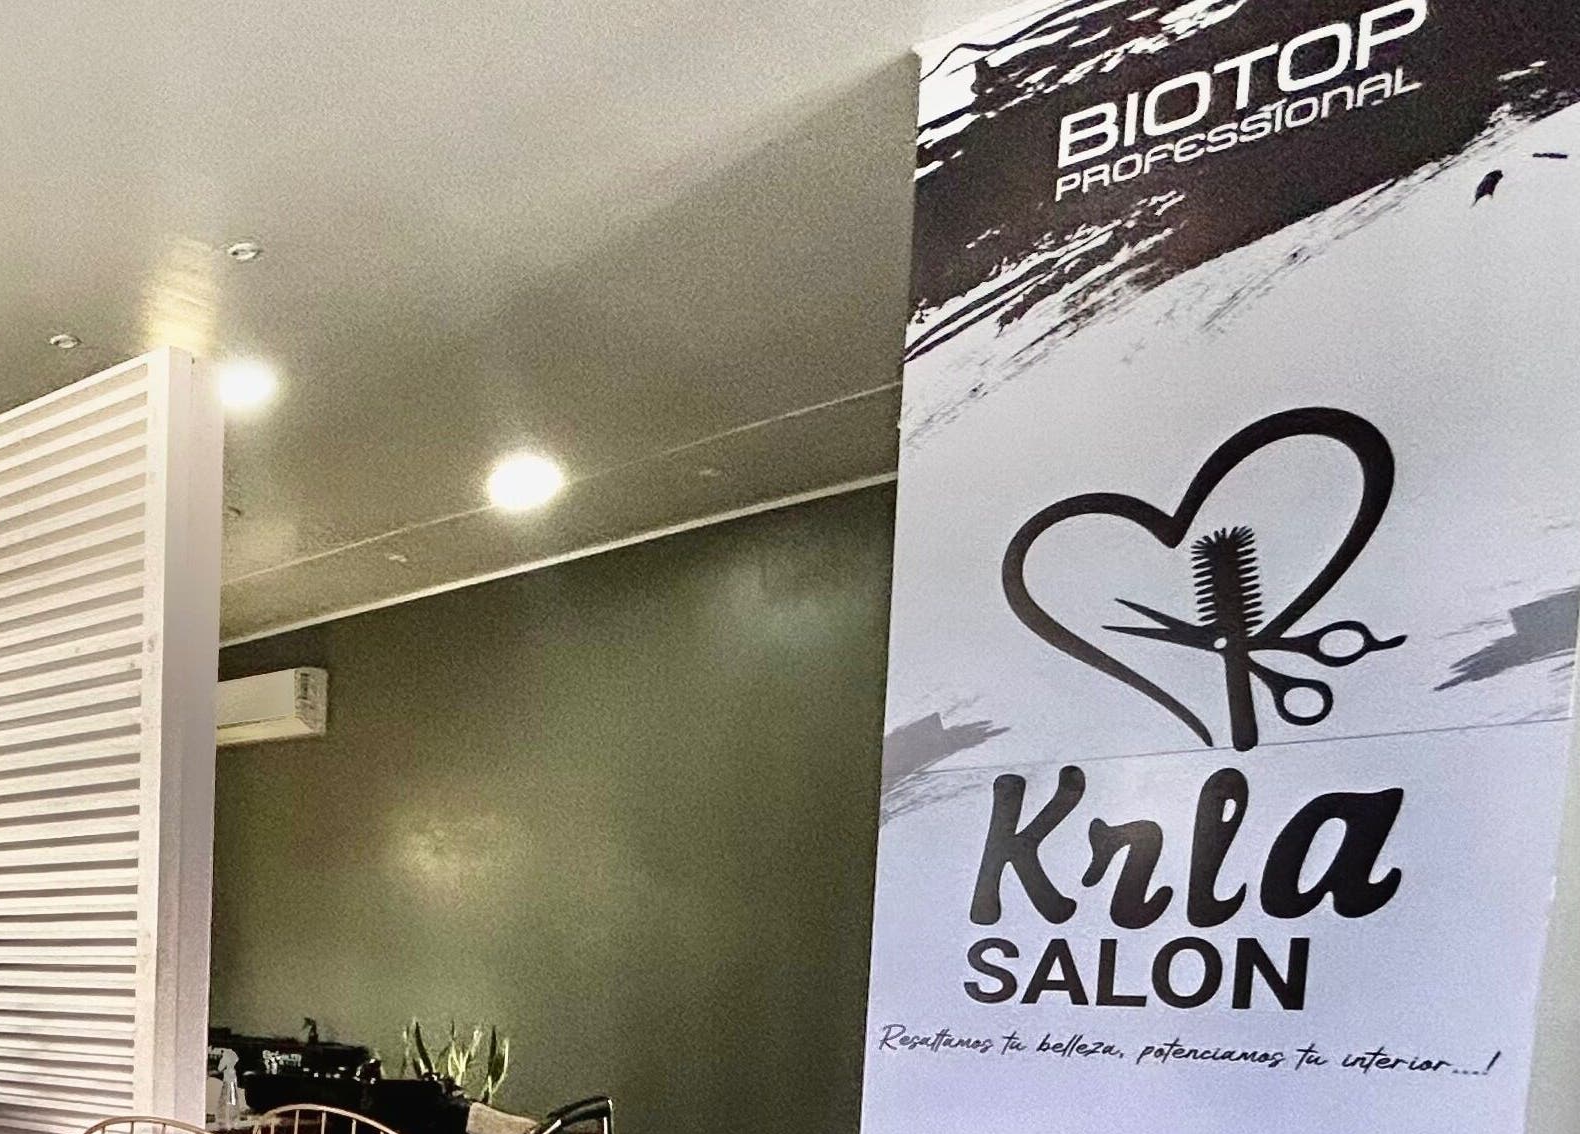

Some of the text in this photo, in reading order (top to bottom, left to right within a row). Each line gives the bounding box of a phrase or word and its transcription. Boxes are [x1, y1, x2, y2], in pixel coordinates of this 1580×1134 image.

[1054, 64, 1423, 202] PROFESSIONAL
[1056, 0, 1429, 169] BIOTOP
[970, 764, 1405, 929] Krla
[964, 936, 1310, 1011] SALON
[1002, 1030, 1027, 1056] tu
[1036, 1033, 1125, 1058] belleza,
[1136, 1037, 1286, 1068] potenciamos
[1295, 1042, 1328, 1070] tu
